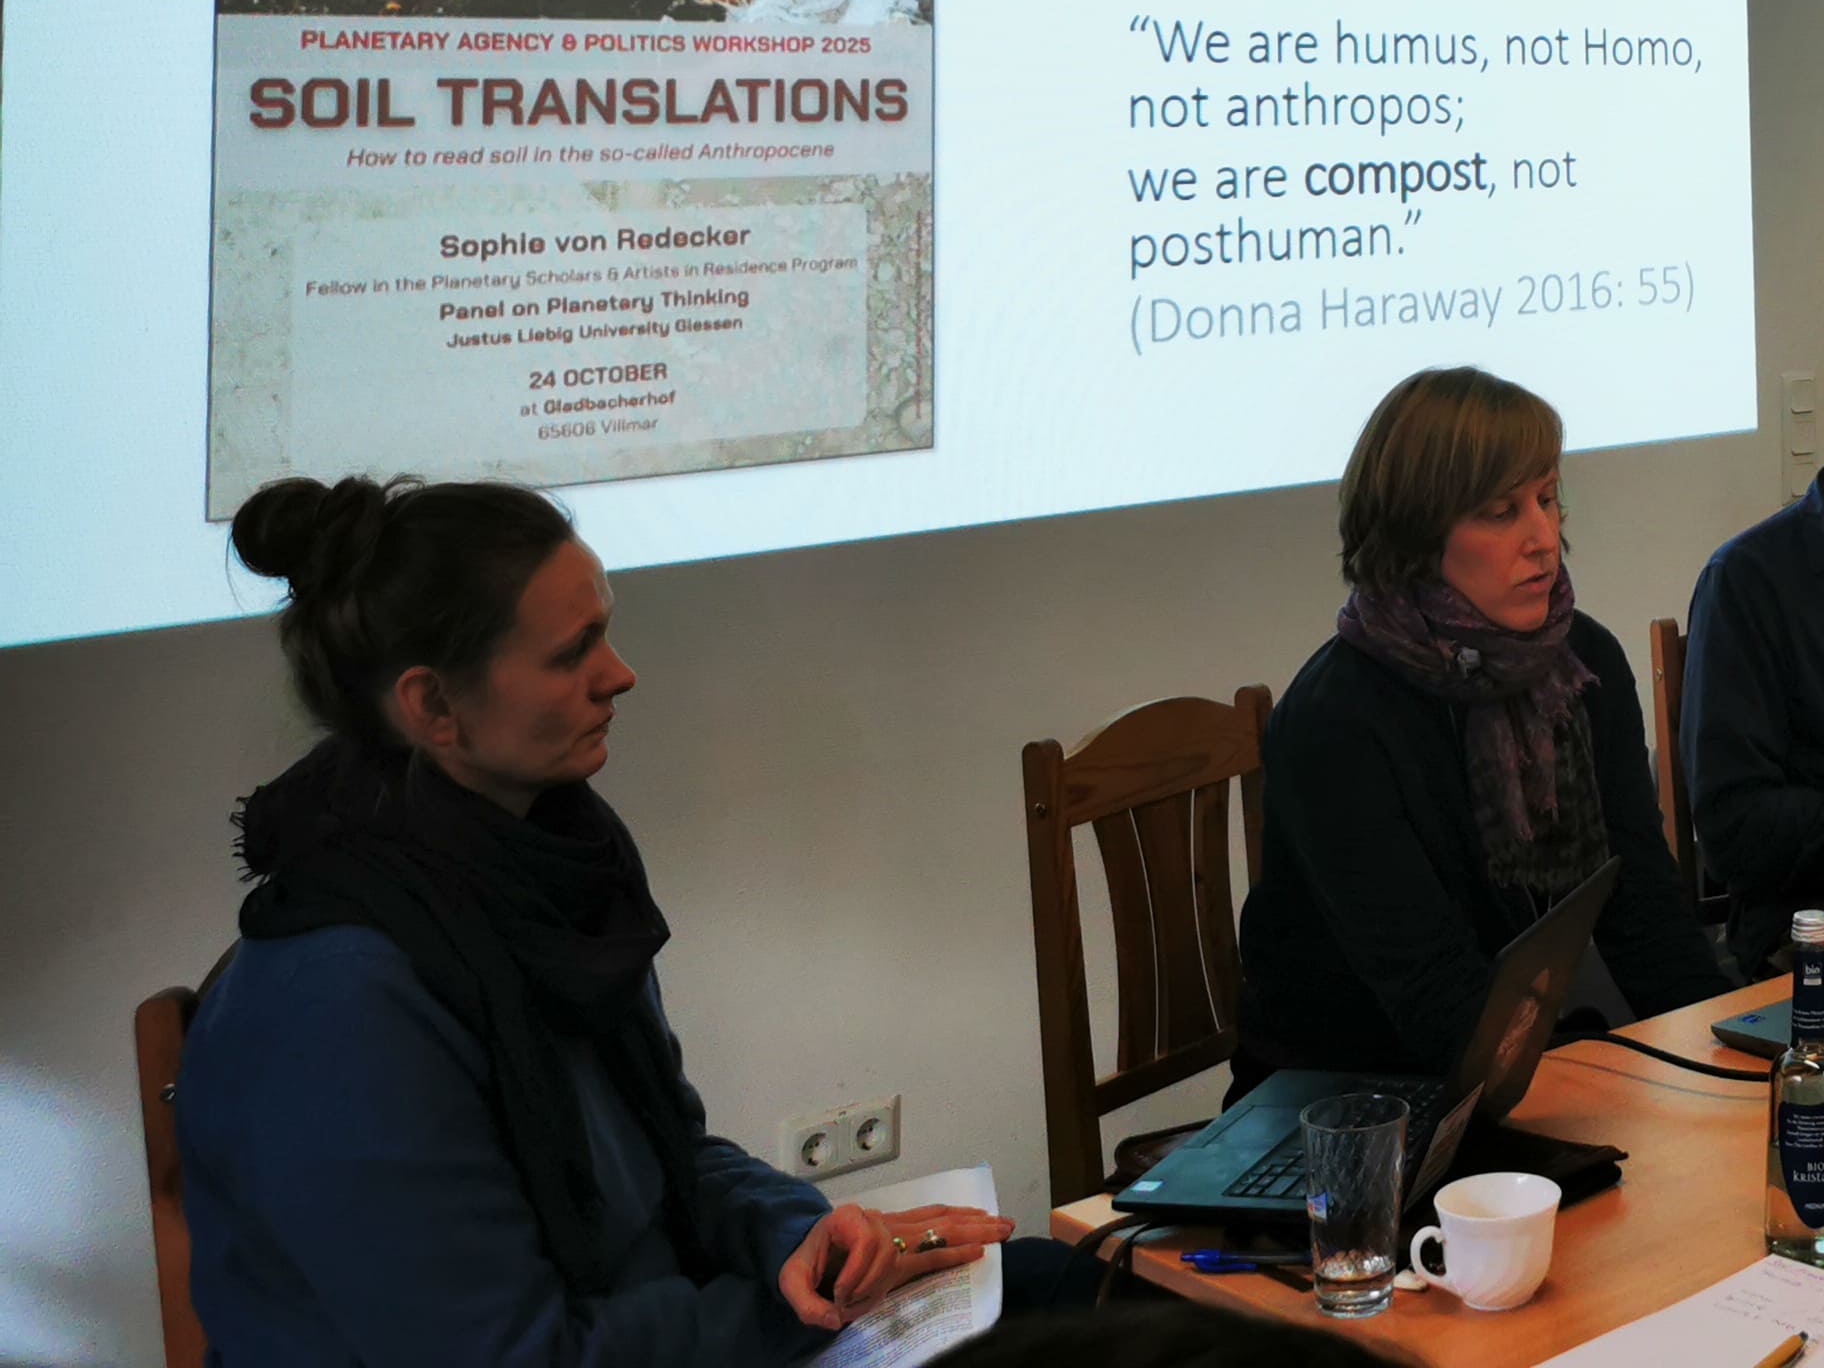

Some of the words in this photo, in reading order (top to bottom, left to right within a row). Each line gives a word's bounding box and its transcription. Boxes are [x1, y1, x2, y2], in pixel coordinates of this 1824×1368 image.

[301, 29, 450, 51] PLANETARY
[457, 31, 554, 52] AGENCY
[584, 33, 686, 53] POLITICS
[692, 35, 815, 54] WORKSHOP
[821, 36, 871, 54] 2025
[1248, 29, 1319, 64] are
[1336, 18, 1489, 73] humus,
[1505, 28, 1569, 65] not
[1583, 27, 1703, 73] Homo,
[249, 77, 416, 129] SOIL
[436, 77, 909, 127] TRANSLATIONS
[1130, 85, 1209, 128] not
[1226, 81, 1465, 137] anthropos;
[347, 148, 398, 168] How
[404, 148, 427, 166] to
[433, 147, 484, 166] read
[489, 145, 528, 164] soil
[533, 145, 552, 163] in
[559, 144, 593, 163] the
[599, 143, 693, 162] so-called
[698, 142, 835, 162] Anthropocene
[1128, 166, 1198, 202] we
[1215, 163, 1288, 199] are
[1304, 152, 1496, 204] compost,
[1512, 151, 1577, 189] not
[440, 232, 546, 262] Sophie
[555, 234, 607, 253] von
[617, 225, 752, 250] Redecker
[306, 280, 368, 296] Fellow
[373, 277, 389, 293] in
[395, 277, 427, 292] the
[431, 273, 521, 290] Planetary
[525, 268, 602, 284] Scholars
[623, 265, 680, 281] Artists
[684, 264, 700, 278] in
[703, 260, 788, 277] Residence
[791, 257, 858, 274] Program
[440, 300, 505, 320] Panel
[512, 301, 540, 317] on
[547, 294, 654, 314] Planetary
[660, 289, 750, 308] Thinking
[1129, 294, 1301, 356] (Donna
[1321, 285, 1502, 332] Haraway
[1516, 269, 1624, 315] 2016:
[1637, 261, 1695, 312] 55)
[446, 330, 512, 349] Justus
[517, 326, 574, 344] Liebig
[579, 320, 670, 339] University
[675, 317, 743, 333] Giessen
[529, 370, 557, 389] 24
[563, 362, 668, 387] OCTOBER
[520, 402, 539, 418] at
